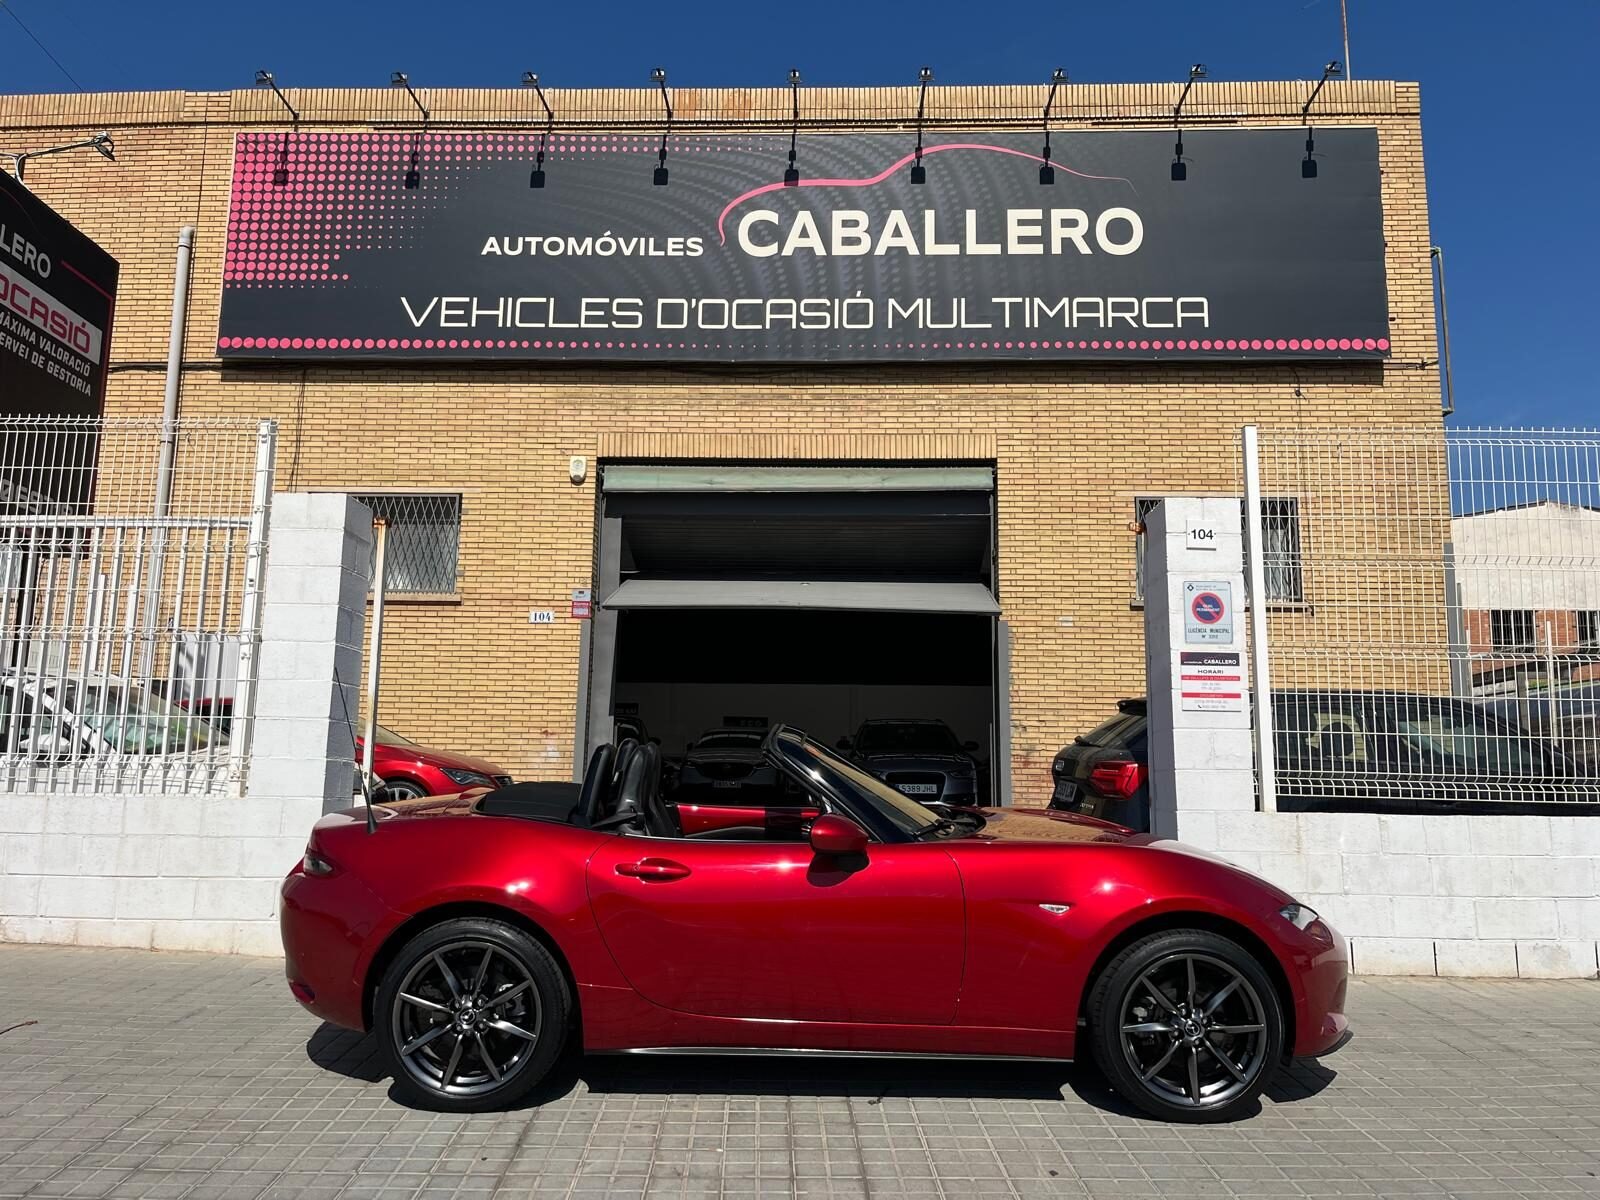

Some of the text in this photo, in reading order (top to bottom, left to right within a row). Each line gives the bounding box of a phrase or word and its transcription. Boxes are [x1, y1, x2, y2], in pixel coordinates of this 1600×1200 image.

[481, 206, 1145, 259] AUTOMÓVILES CABALLERO
[400, 296, 643, 329] VEHICLES
[656, 290, 875, 330] D'OCASIÓ
[31, 351, 46, 369] DE
[47, 360, 92, 397] GESTORIA
[38, 335, 91, 377] VALORACIÓ
[1191, 529, 1214, 540] 104
[534, 612, 551, 621] 104
